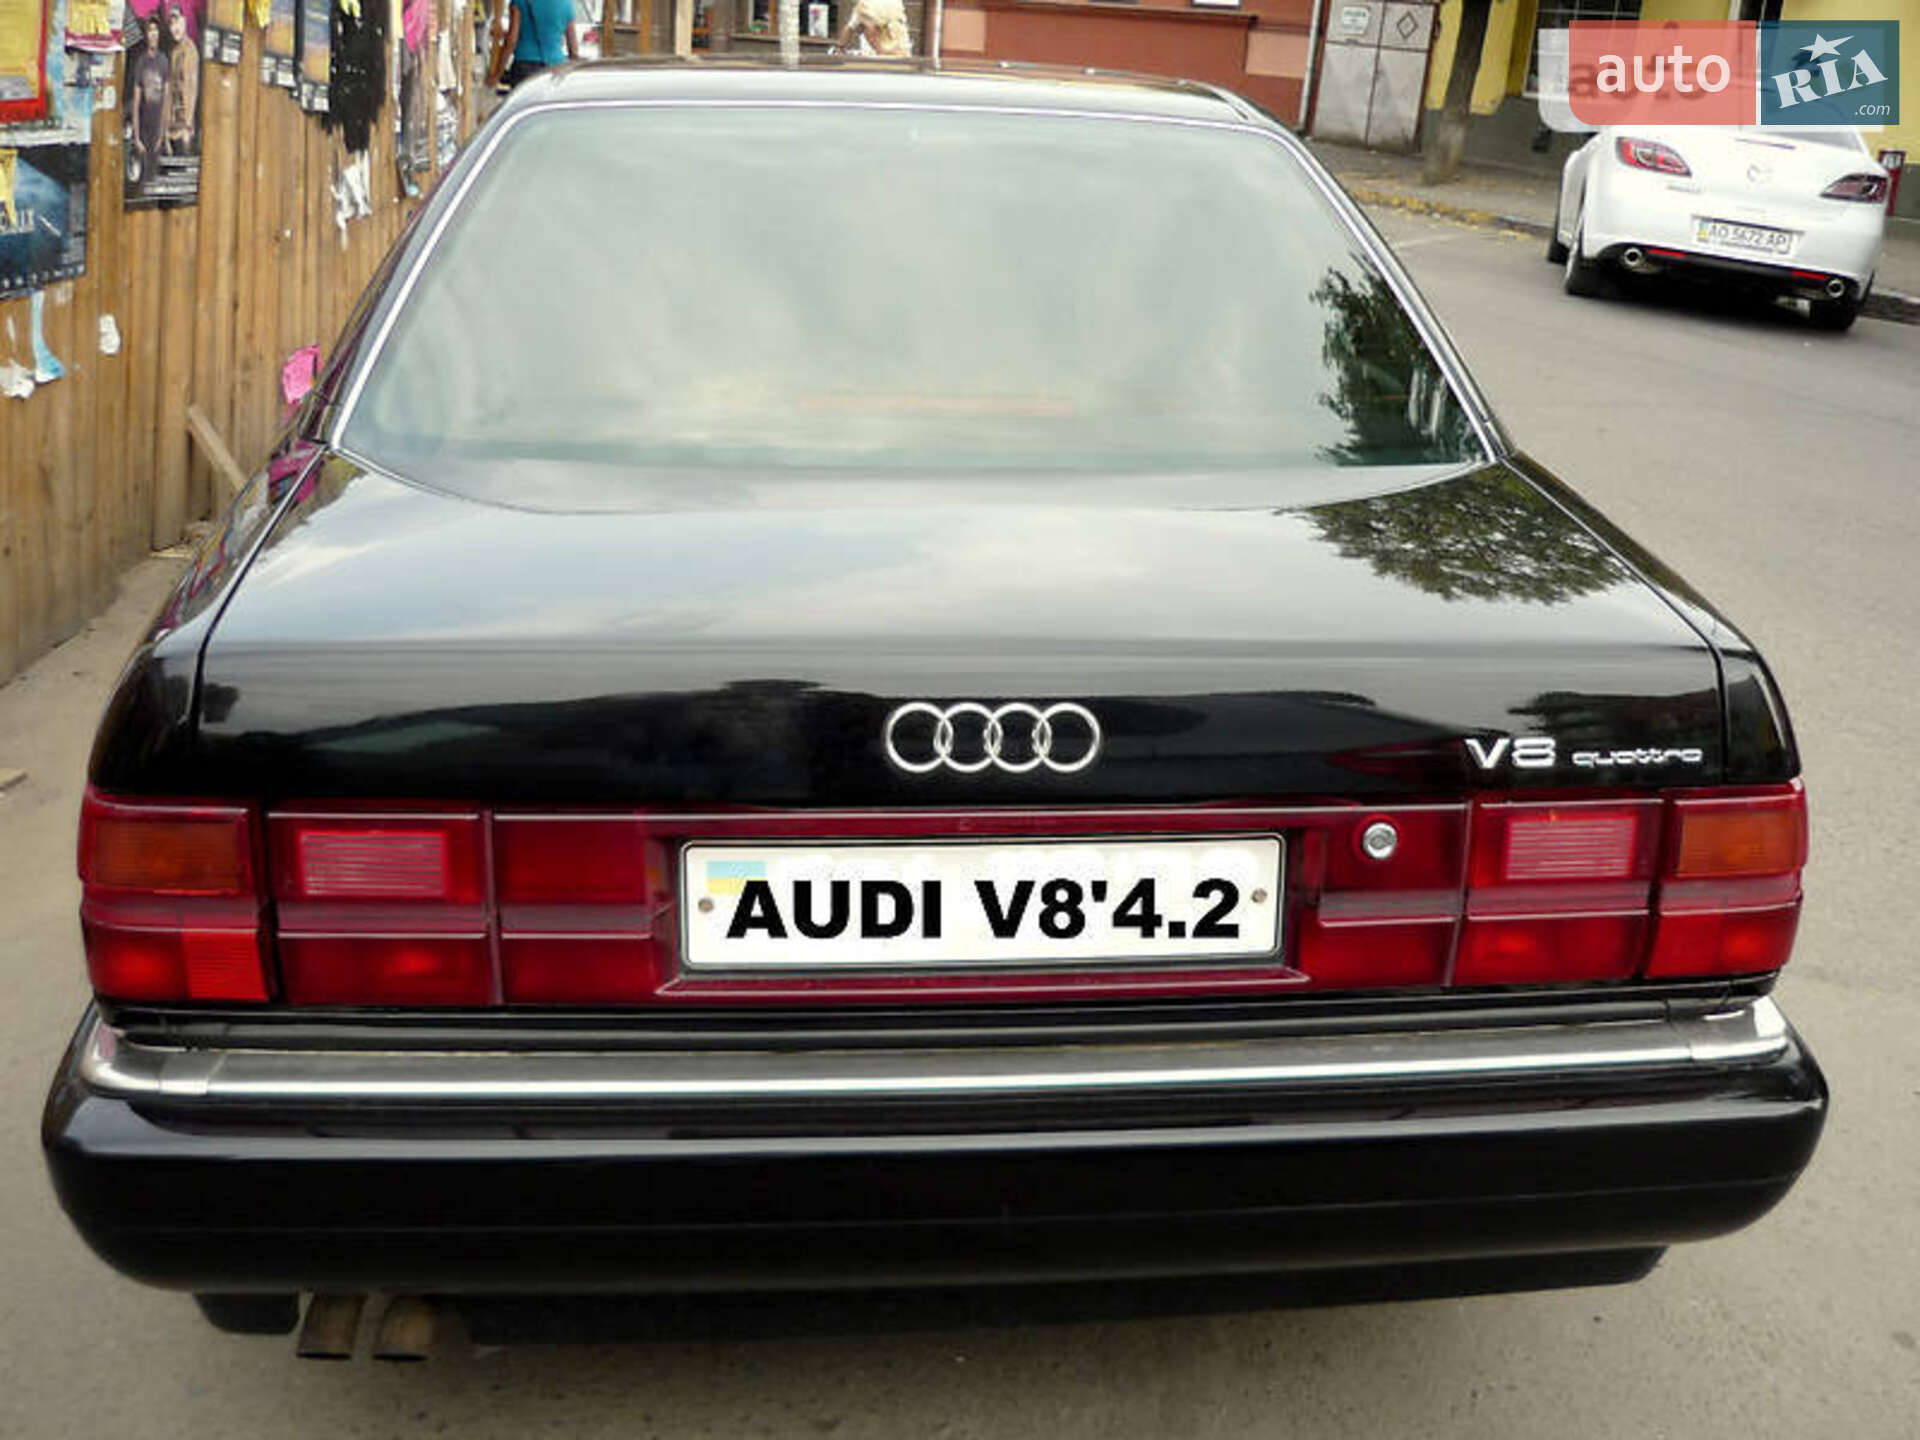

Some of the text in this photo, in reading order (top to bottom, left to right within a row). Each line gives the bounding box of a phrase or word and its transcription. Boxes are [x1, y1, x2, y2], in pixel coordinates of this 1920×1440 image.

[1464, 737, 1702, 769] V8 quattro
[725, 877, 1240, 939] AUDI V8'4.2
